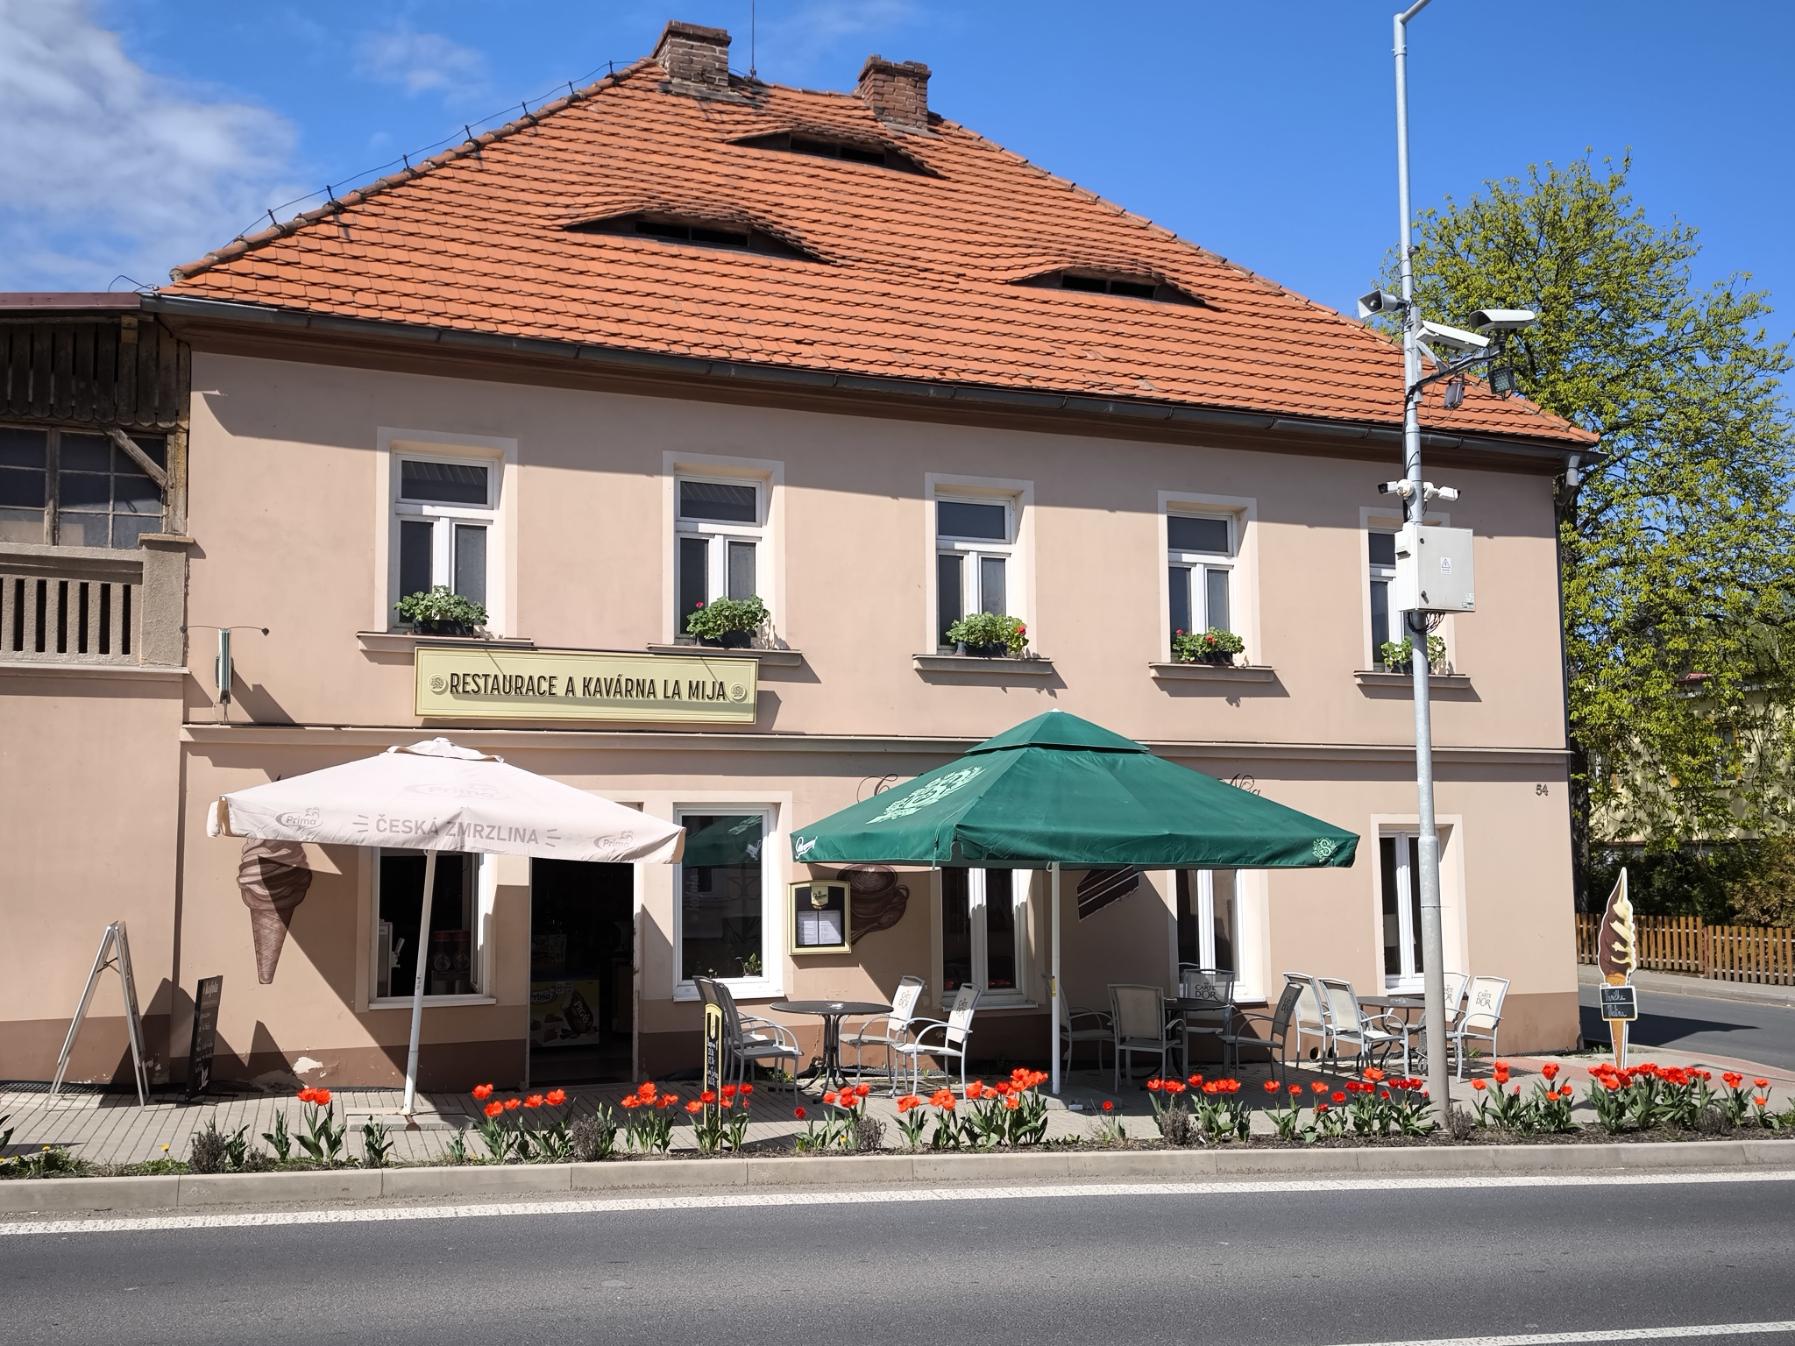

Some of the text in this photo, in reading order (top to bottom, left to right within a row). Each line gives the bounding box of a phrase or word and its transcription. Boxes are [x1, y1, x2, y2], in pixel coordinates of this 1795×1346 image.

[450, 673, 727, 702] RESTAURACE A KAVÁRNA LA MIJA
[1536, 783, 1549, 797] 54
[286, 815, 317, 825] Prima
[376, 813, 539, 845] ČESKÁ ZMRZLINA
